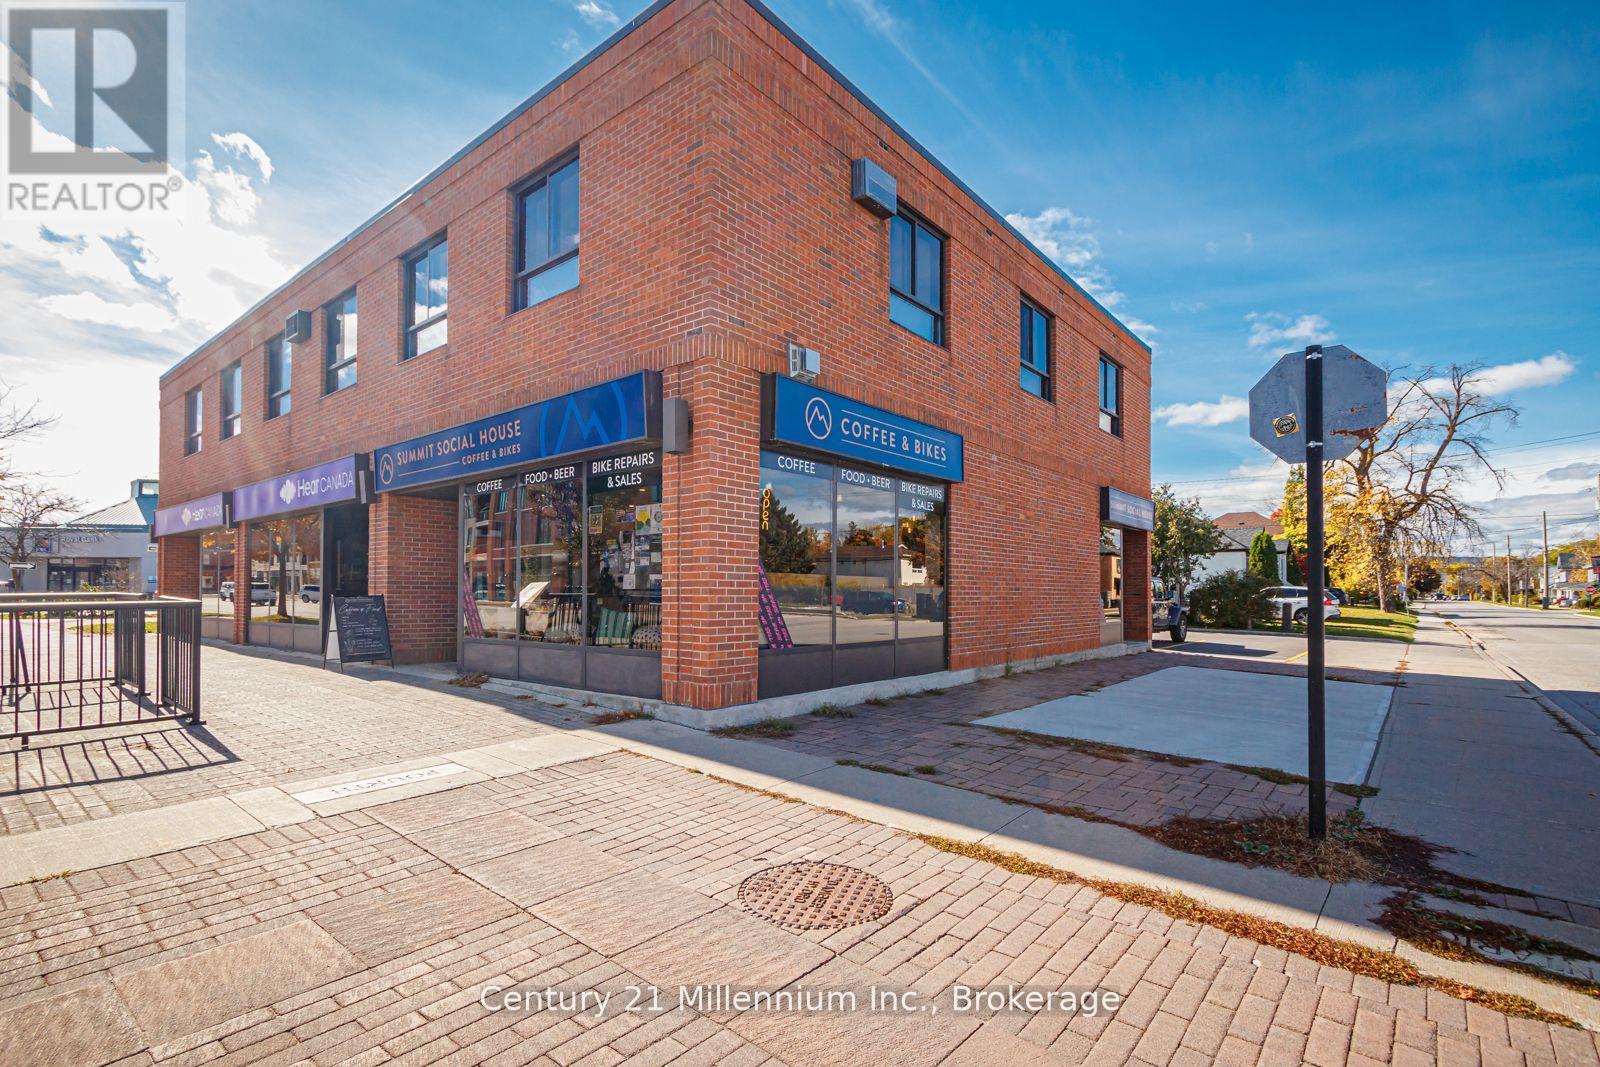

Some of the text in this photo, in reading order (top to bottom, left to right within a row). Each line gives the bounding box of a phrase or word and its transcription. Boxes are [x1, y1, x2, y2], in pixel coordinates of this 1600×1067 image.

[396, 419, 521, 466] SUMMIT SOCIAL HOUSE
[841, 417, 947, 462] COFFEE & BIKES
[462, 443, 521, 465] COFFEE & BIKES
[592, 451, 654, 474] BIKE REPAIRS
[777, 455, 816, 474] COFFEE
[525, 466, 575, 485] FOOD BEER
[607, 472, 642, 488] & SALES
[841, 469, 891, 490] FOOD BEER
[476, 479, 503, 493] COFFEE
[901, 481, 942, 500] BIKE REPAIRS
[762, 488, 771, 530] open
[911, 498, 934, 511] & SALES
